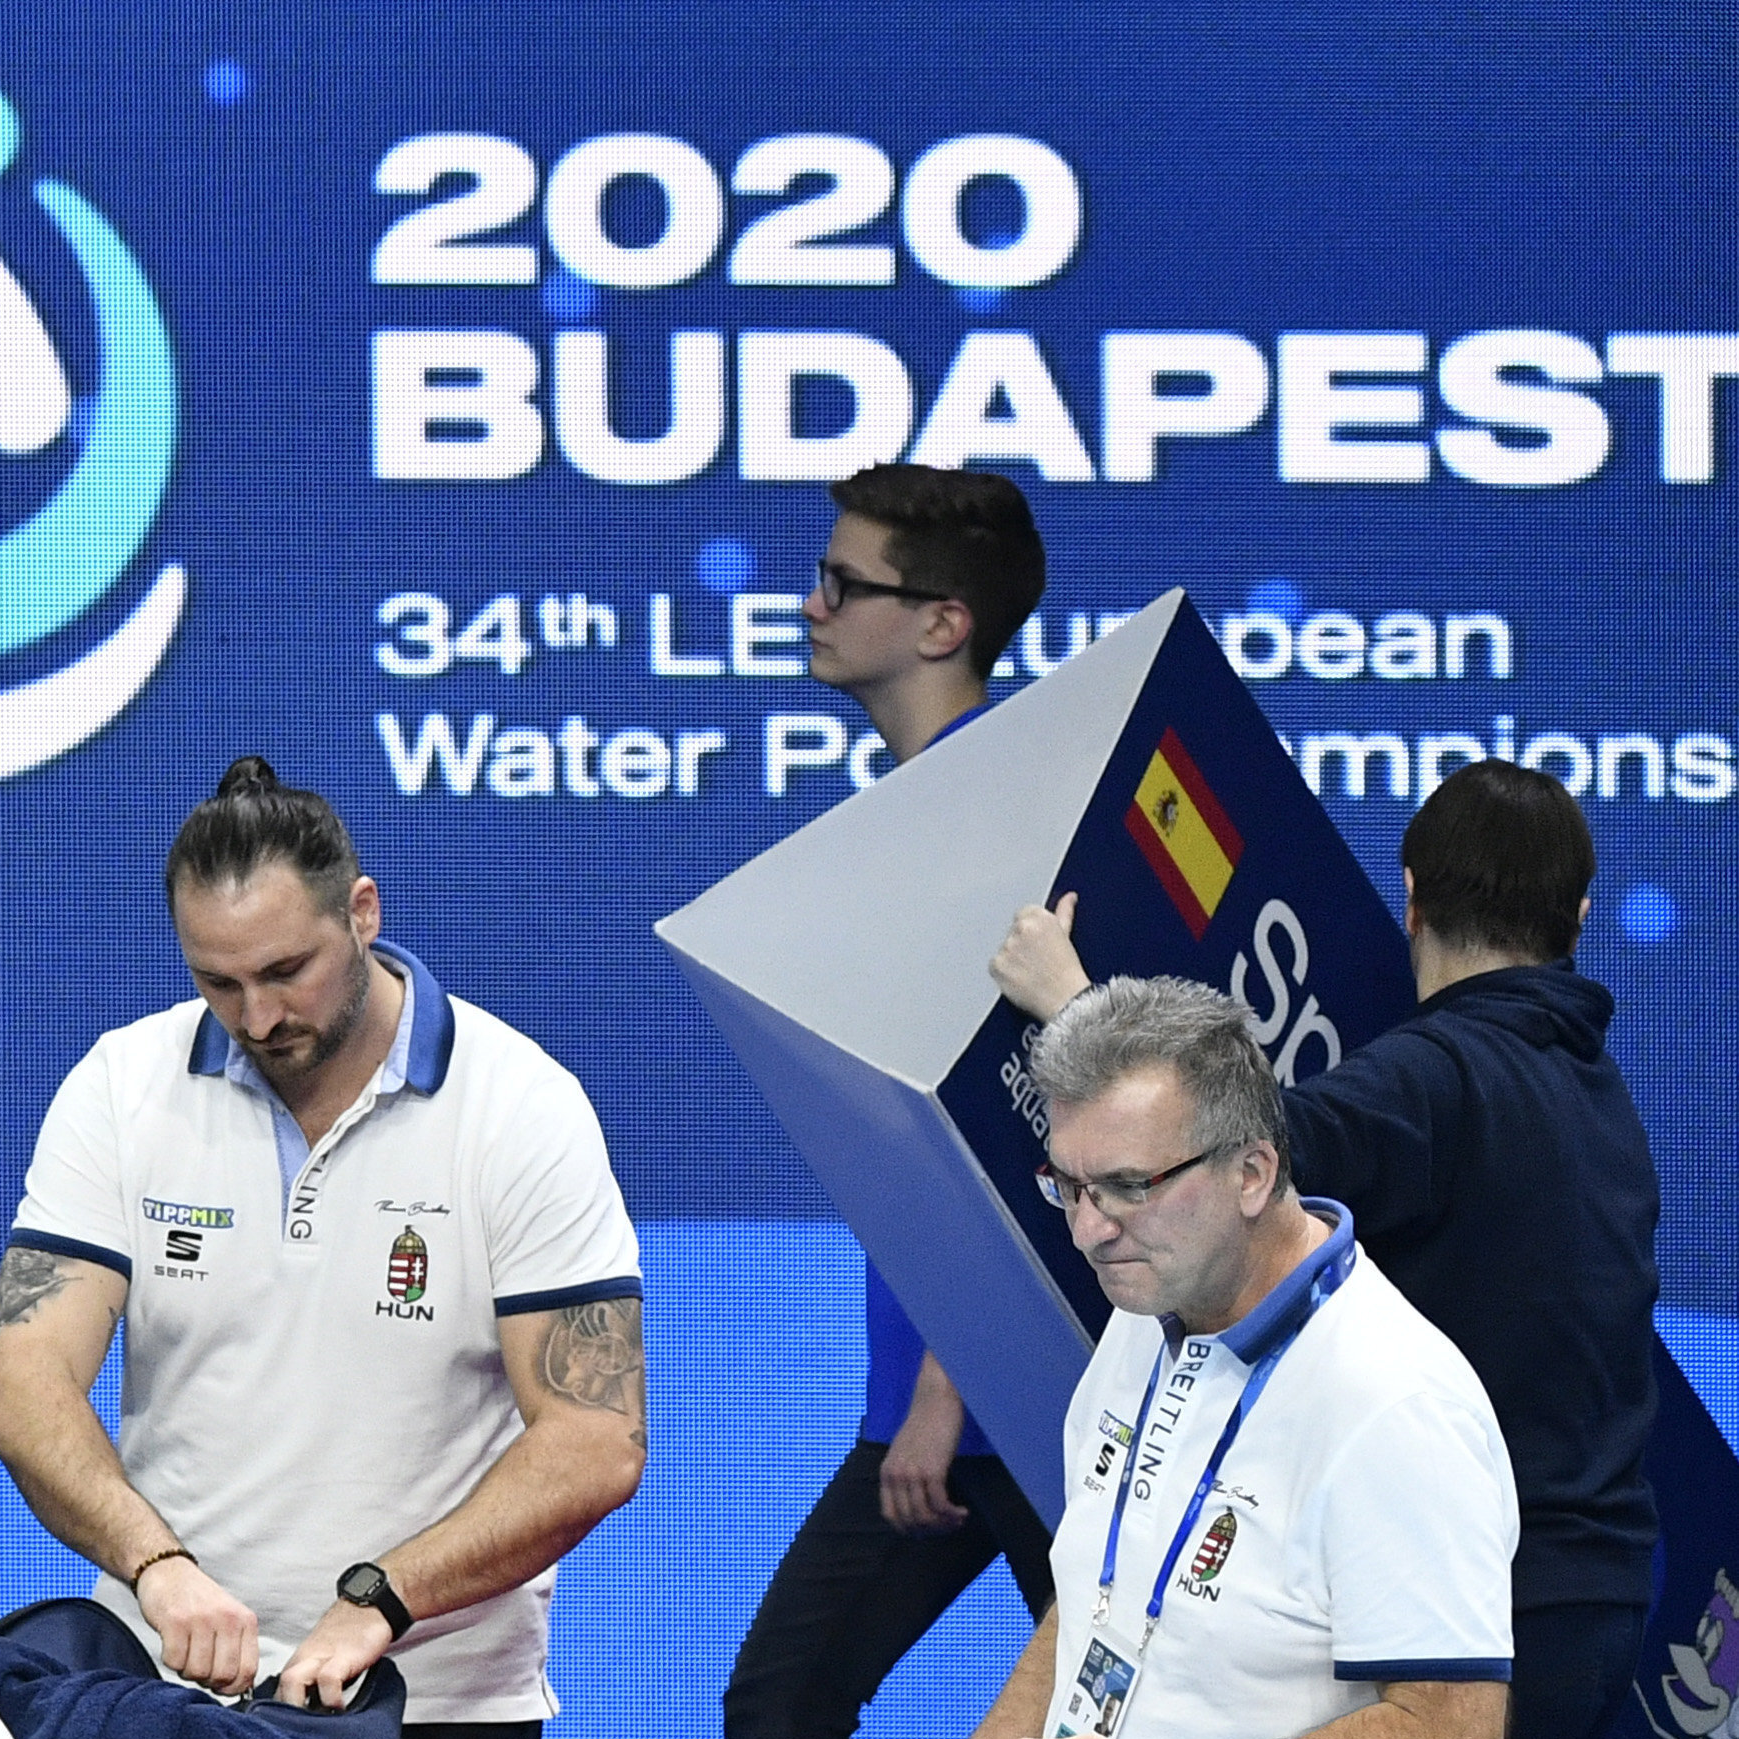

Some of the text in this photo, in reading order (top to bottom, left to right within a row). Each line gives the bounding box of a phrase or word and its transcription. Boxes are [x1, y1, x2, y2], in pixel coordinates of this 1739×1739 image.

[371, 132, 1082, 289] 2020
[370, 330, 1739, 486] BUDAPEST
[649, 593, 813, 676] LE
[376, 714, 727, 797] Water
[153, 1264, 210, 1282] SEAT
[375, 1300, 435, 1322] HUN
[1133, 1342, 1212, 1502] BREITLING
[1175, 1573, 1222, 1603] HUN
